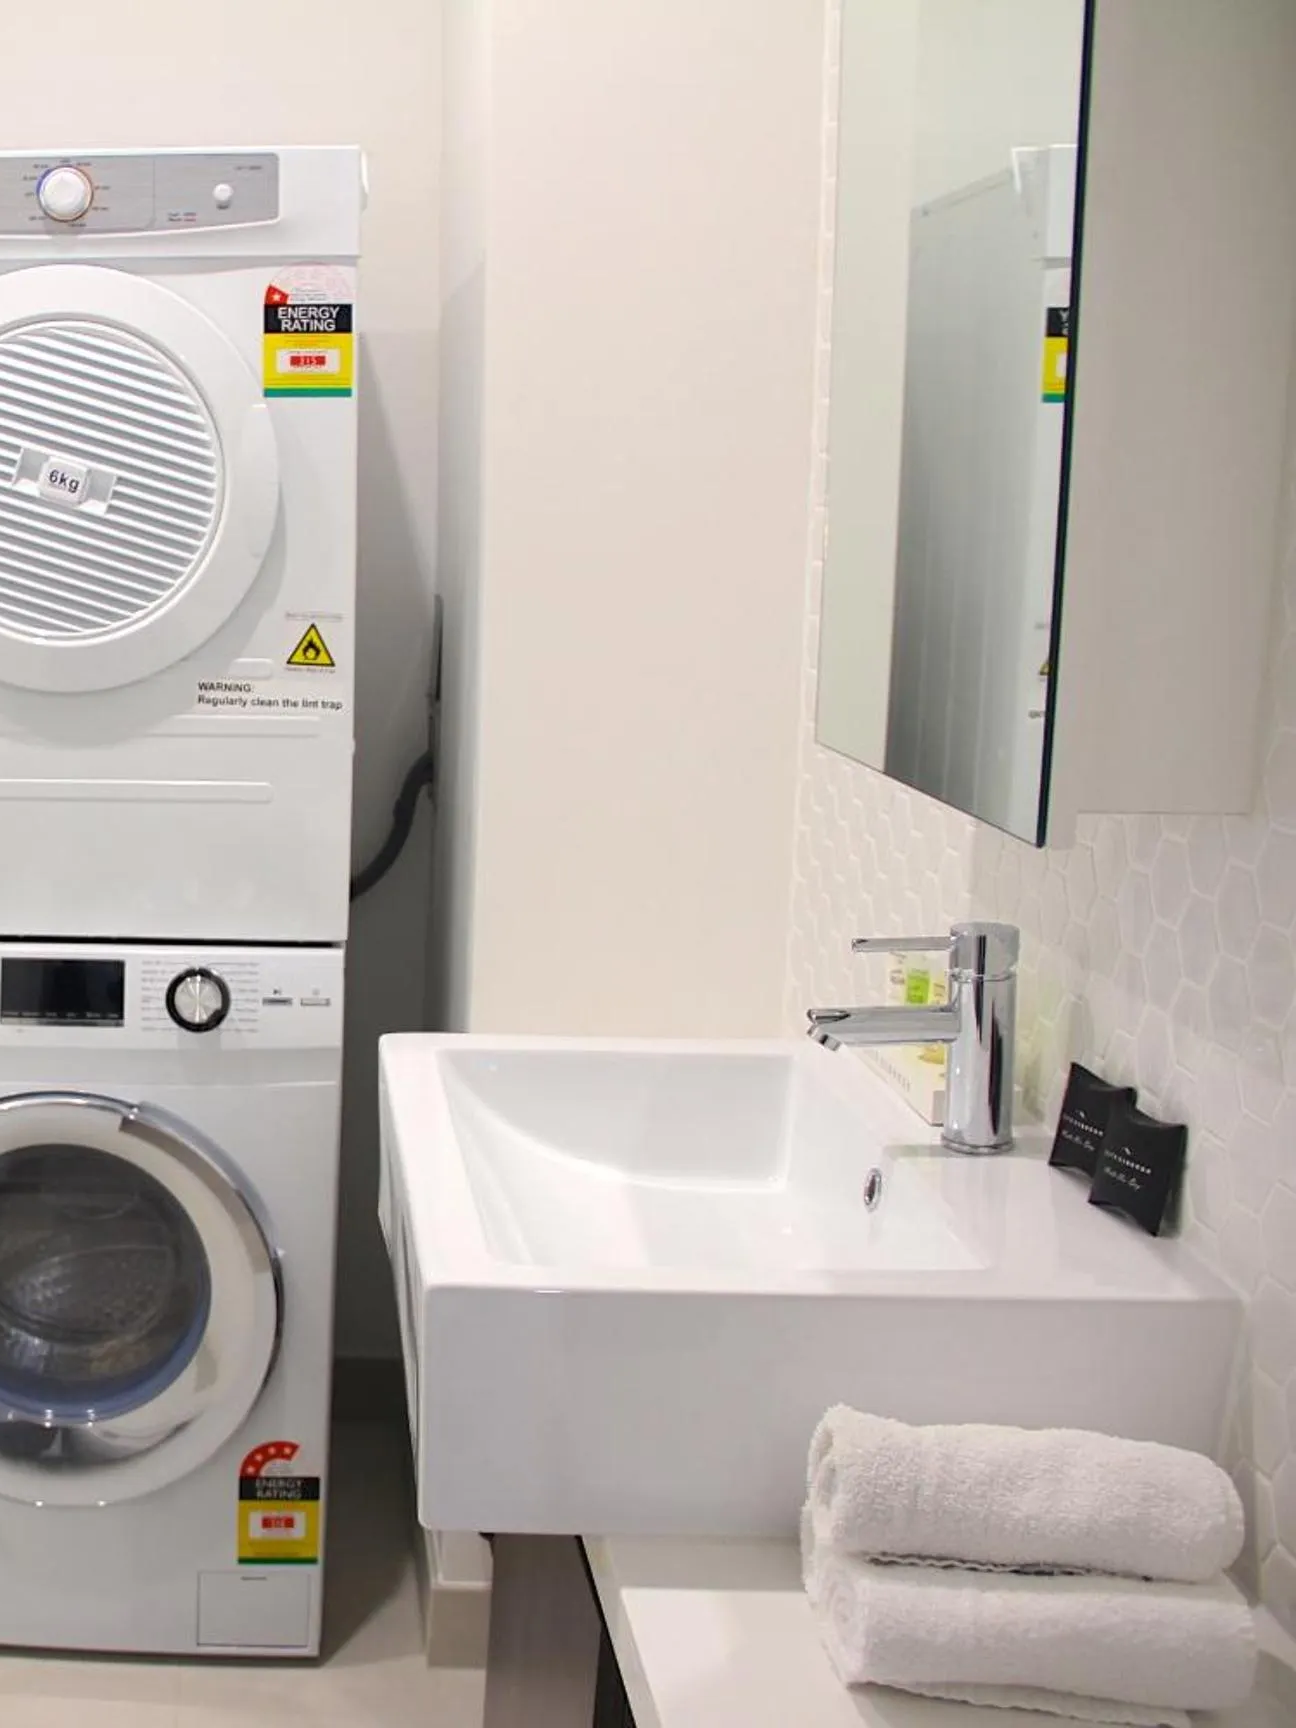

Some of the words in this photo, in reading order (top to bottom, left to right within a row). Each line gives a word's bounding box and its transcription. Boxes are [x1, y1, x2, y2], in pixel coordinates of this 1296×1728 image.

[277, 306, 340, 319] ENERGY
[281, 319, 336, 332] RATING
[48, 469, 81, 494] 6kg
[197, 694, 248, 708] Regularly
[251, 696, 280, 707] clean
[282, 698, 300, 708] the
[302, 698, 319, 709] lint
[321, 700, 343, 711] trap
[255, 1479, 304, 1489] ENERGY
[256, 1489, 302, 1499] RATING
